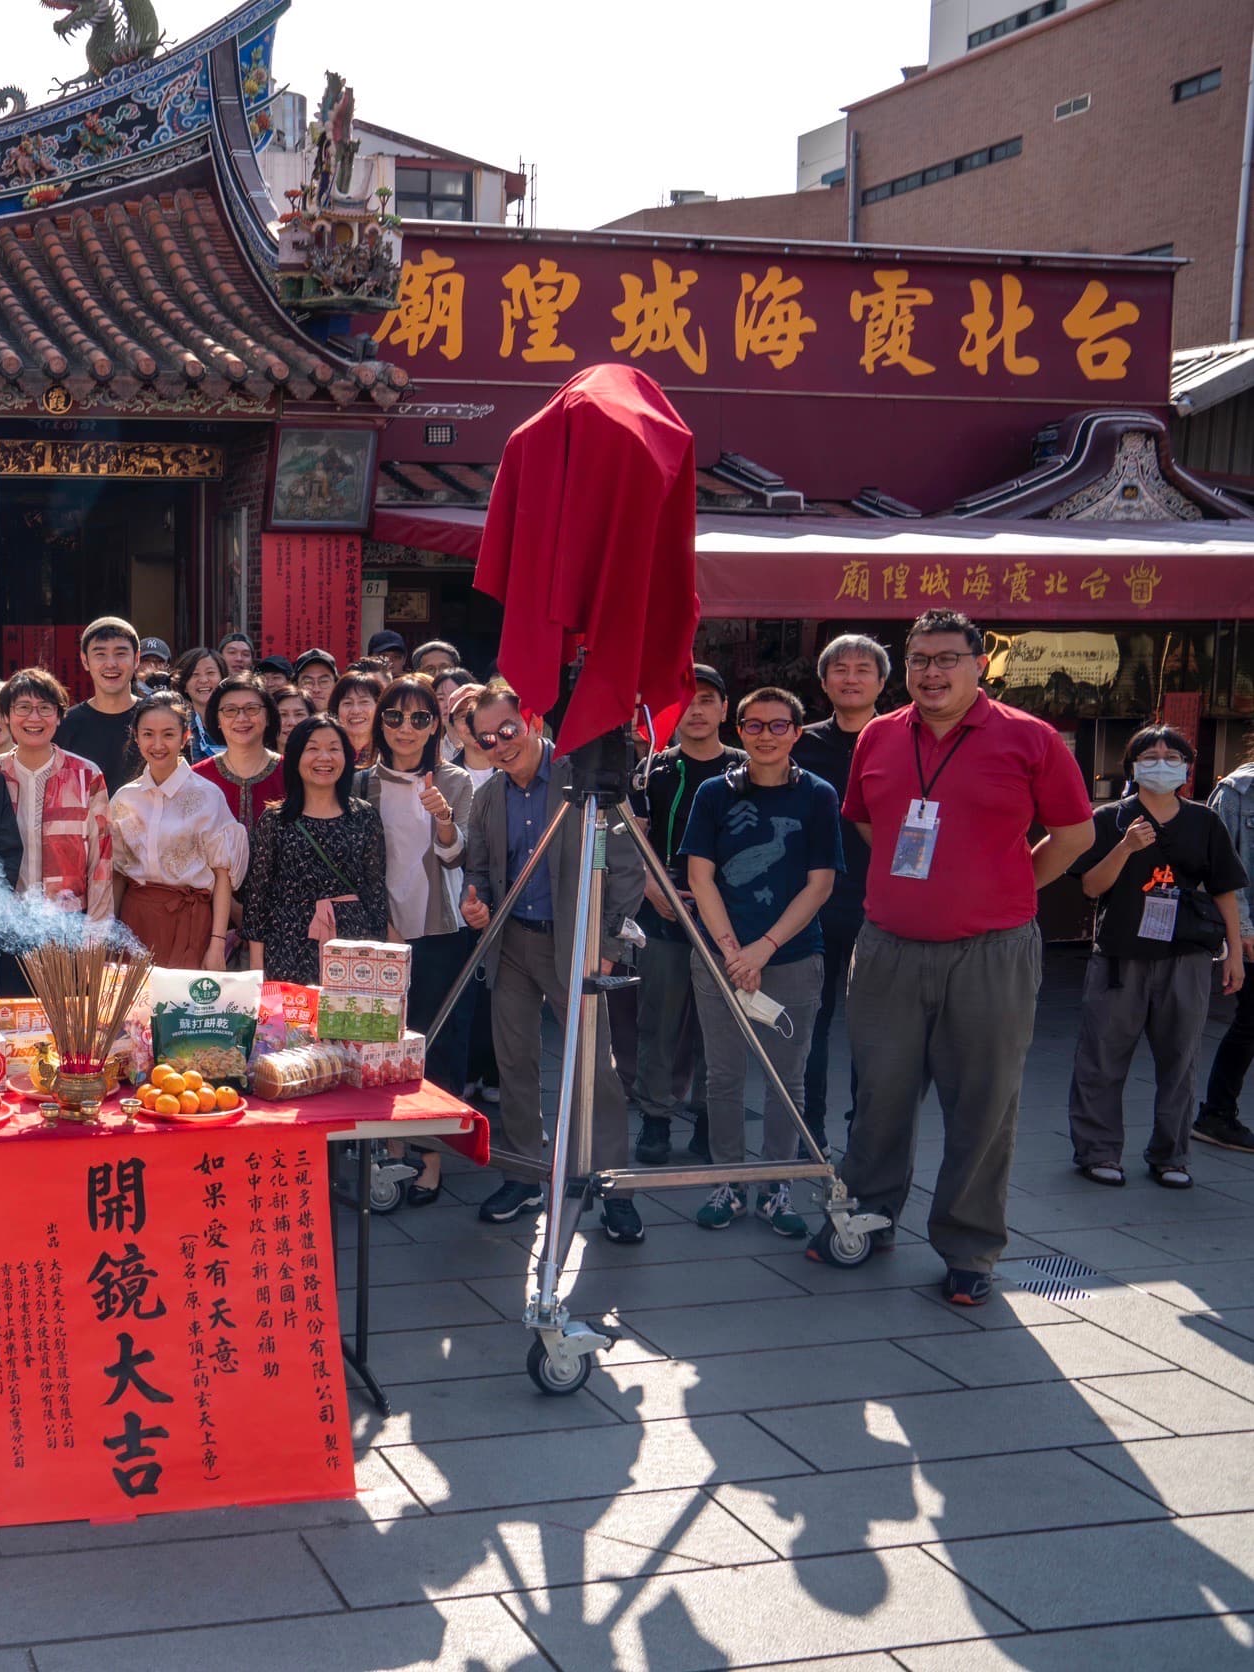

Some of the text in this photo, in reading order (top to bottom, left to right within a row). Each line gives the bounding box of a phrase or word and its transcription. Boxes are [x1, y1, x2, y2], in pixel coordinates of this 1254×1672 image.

[372, 248, 1141, 381] 台北霞海城隍廟
[366, 582, 380, 594] 61
[834, 559, 1112, 603] 台北霞海城隍廟
[283, 993, 308, 1007] QQ
[179, 1018, 230, 1030] 蘇打餅乾
[46, 1222, 60, 1249] 出品
[268, 1149, 299, 1329] 文化部輔導金國片
[194, 1152, 240, 1375] 如果愛有天意
[87, 1156, 175, 1499] 開鏡大吉
